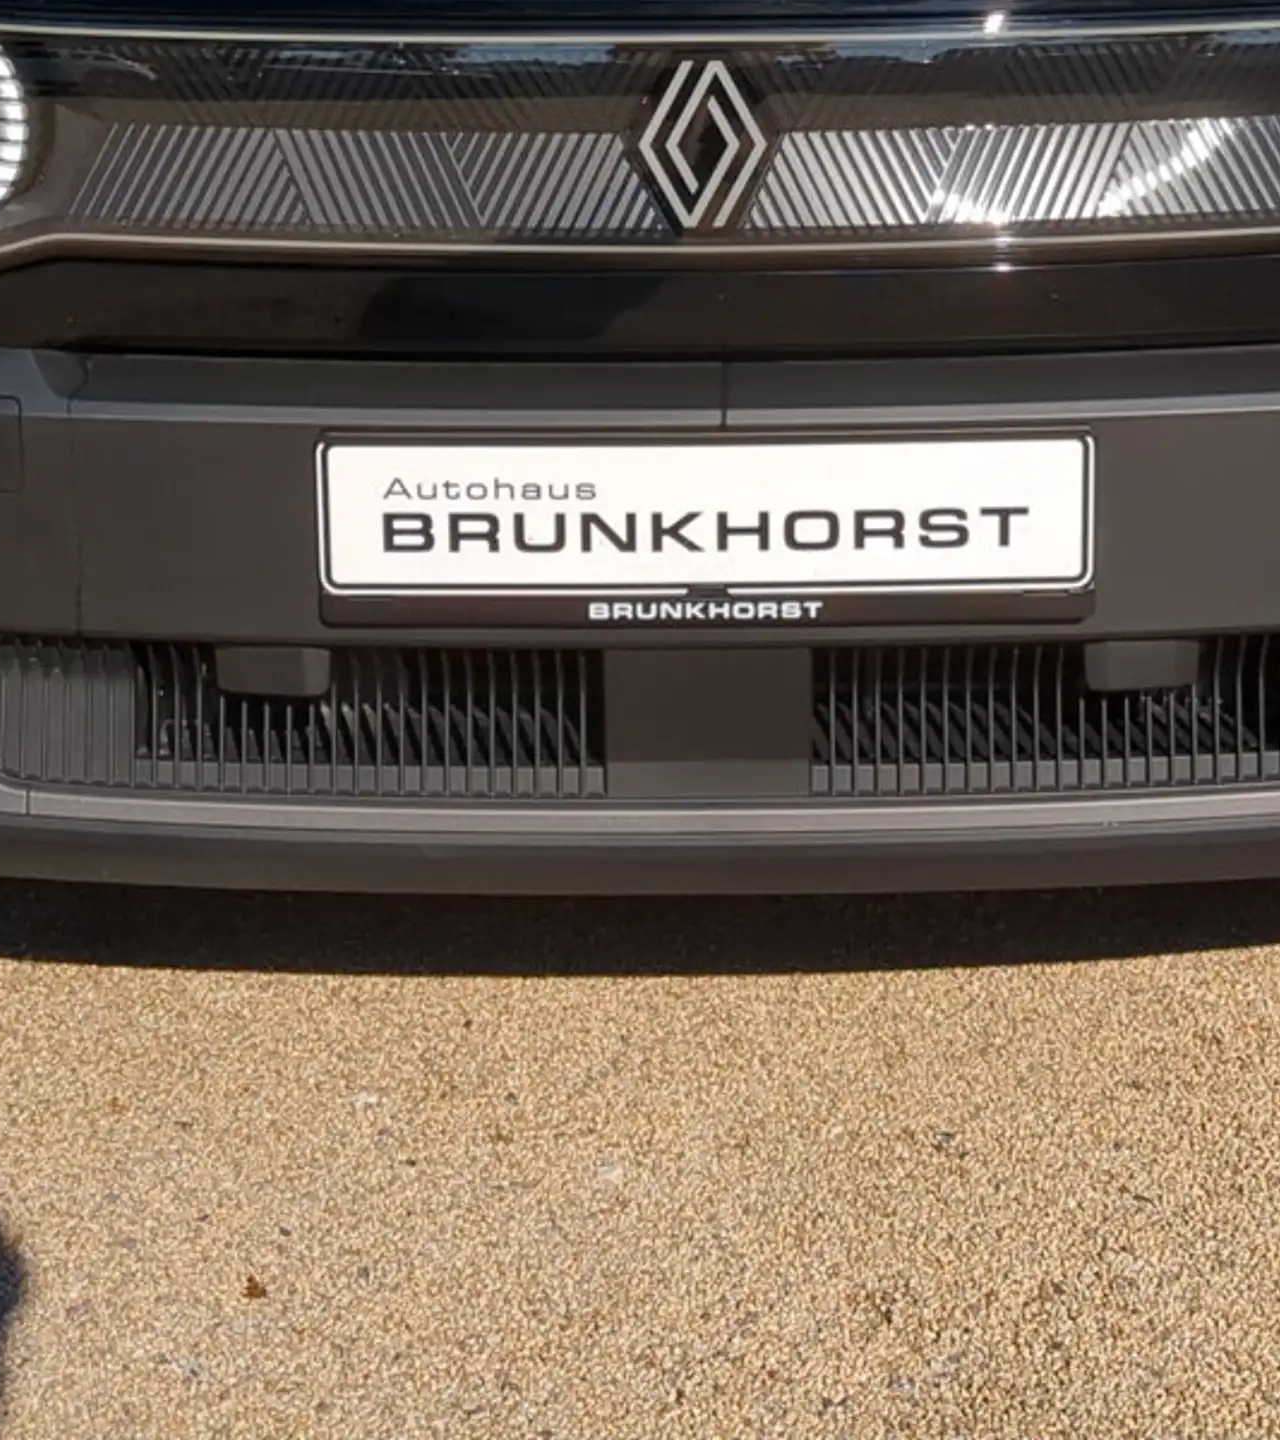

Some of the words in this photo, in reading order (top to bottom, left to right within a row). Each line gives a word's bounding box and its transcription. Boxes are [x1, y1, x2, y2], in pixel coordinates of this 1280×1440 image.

[383, 477, 596, 501] Autohaus
[382, 506, 1029, 553] BRUNKHORST
[589, 601, 823, 620] BRUNKHORST
